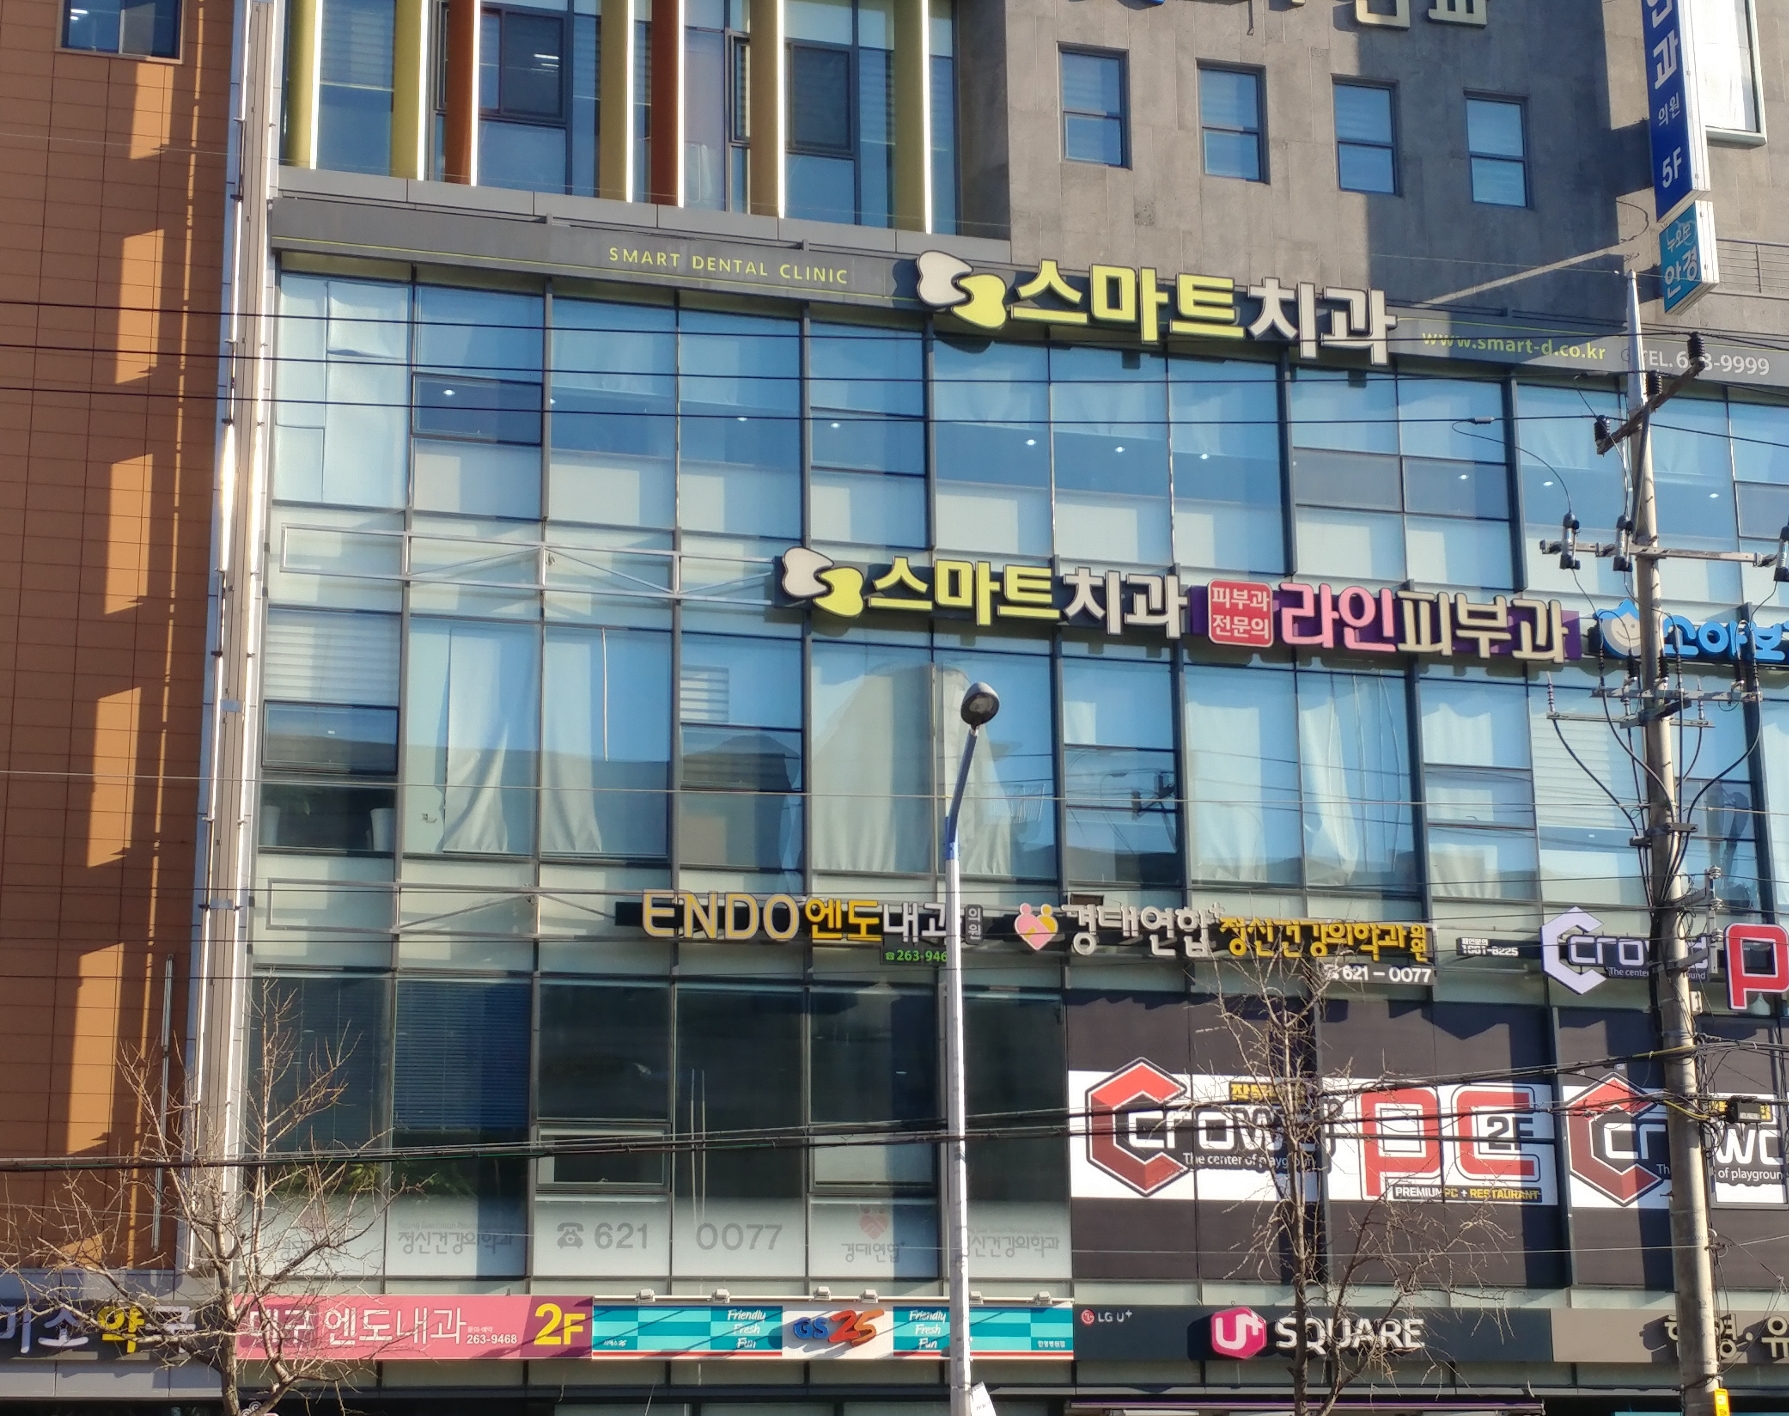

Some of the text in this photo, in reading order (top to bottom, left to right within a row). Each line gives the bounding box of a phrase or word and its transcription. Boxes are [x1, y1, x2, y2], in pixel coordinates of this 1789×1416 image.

[1658, 92, 1680, 126] 의원
[1662, 147, 1682, 188] 5F
[609, 247, 848, 285] SMART DENTAL CLINIC
[1665, 246, 1698, 299] 안경
[1010, 259, 1397, 364] 스마트치과
[1422, 332, 1606, 360] www.smart-d.co.kr
[868, 556, 1187, 639] 스마트치과
[1211, 588, 1270, 608] 피부과
[1212, 614, 1271, 639] 전문의
[641, 889, 799, 941] ENDO
[969, 907, 981, 940] 의원
[896, 949, 949, 963] 263-946
[1485, 1114, 1535, 1151] 2F
[1183, 1152, 1205, 1165] The
[1207, 1154, 1242, 1166] center
[1717, 1168, 1730, 1179] of
[1731, 1168, 1784, 1181] playgroun
[594, 1222, 783, 1251] 621 0077
[323, 1307, 467, 1346] 엔도내과
[533, 1303, 586, 1346] 2F
[727, 1309, 766, 1323] Friendly
[734, 1323, 761, 1335] Fresh
[909, 1309, 947, 1323] Friendly
[1098, 1312, 1113, 1322] LG
[466, 1334, 517, 1345] 263-9468
[915, 1324, 941, 1335] Fresh
[737, 1338, 757, 1349] Fun
[918, 1337, 938, 1349] Fun
